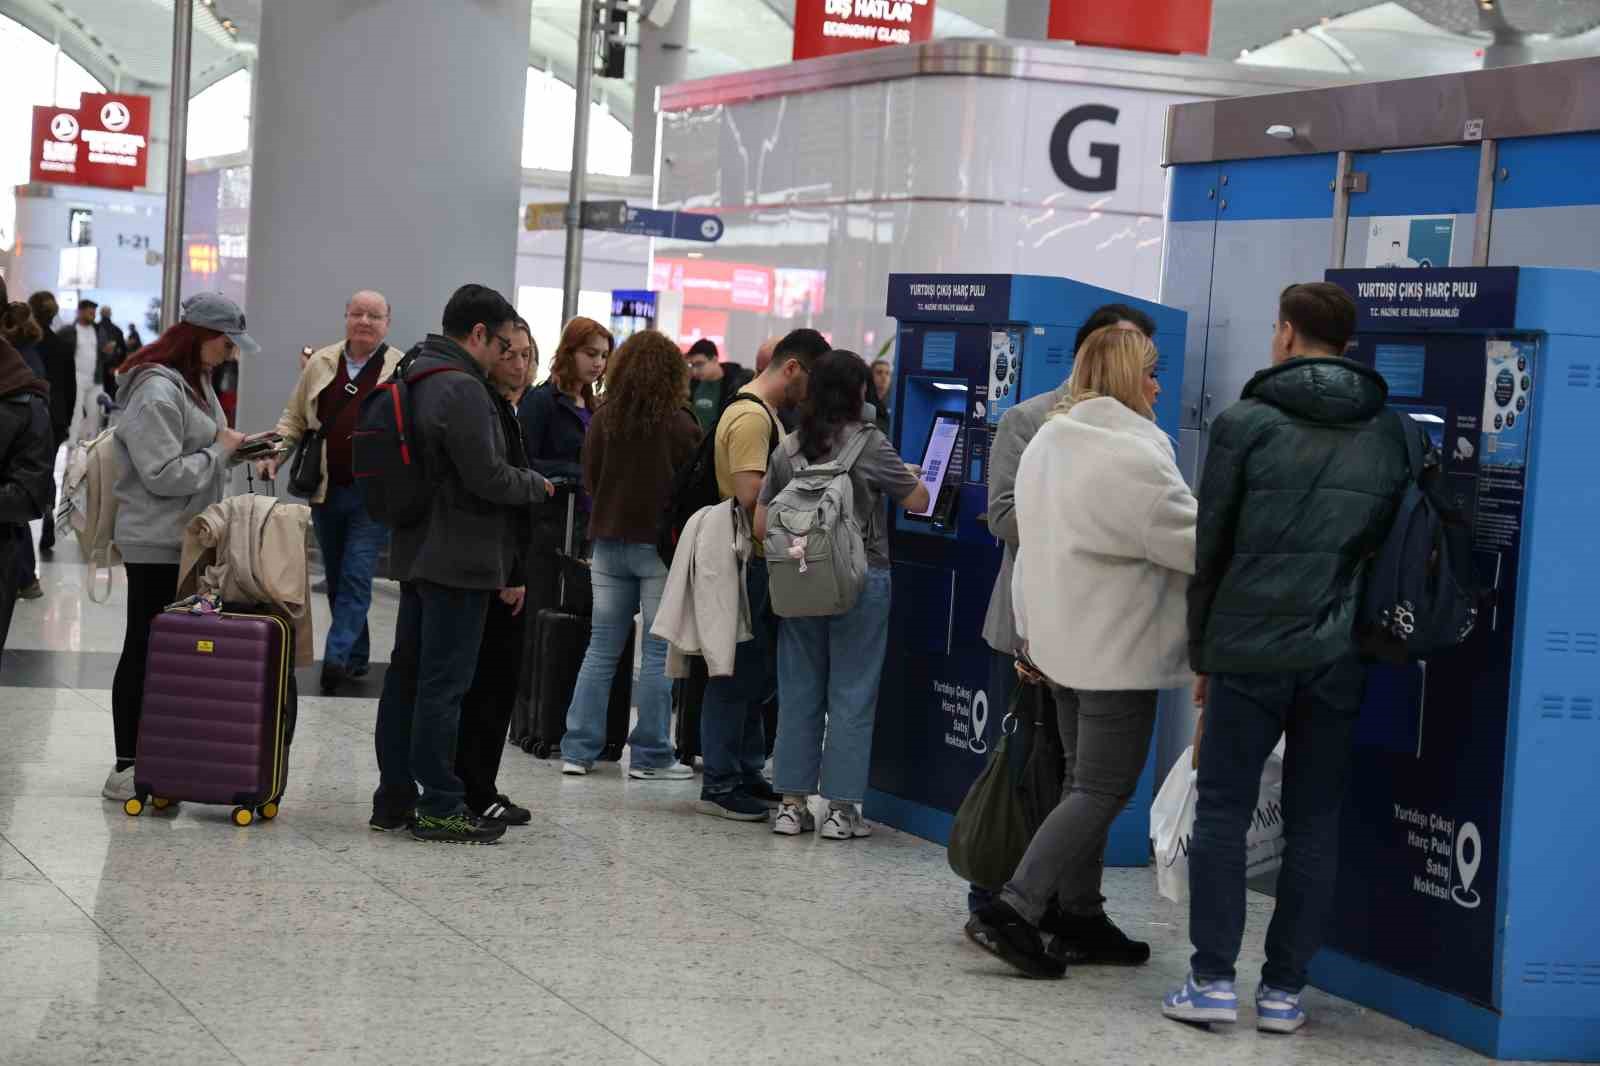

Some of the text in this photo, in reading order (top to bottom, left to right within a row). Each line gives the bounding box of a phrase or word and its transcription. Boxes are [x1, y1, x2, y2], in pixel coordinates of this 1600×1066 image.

[854, 1, 912, 22] HATLAR
[823, 21, 910, 43] ECONOMY CLASS
[1049, 104, 1120, 193] G
[910, 284, 986, 300] YURTDIŞI ÇIKIŞ HARÇ PULU
[1358, 281, 1478, 301] YURTDIŞI ÇIKIŞ HARÇ PULU
[1394, 803, 1452, 837] Yurtdışı Çıkış
[1408, 830, 1451, 857] Harç Pulu
[1425, 858, 1449, 881] Satış
[1413, 875, 1450, 900] Noktası
